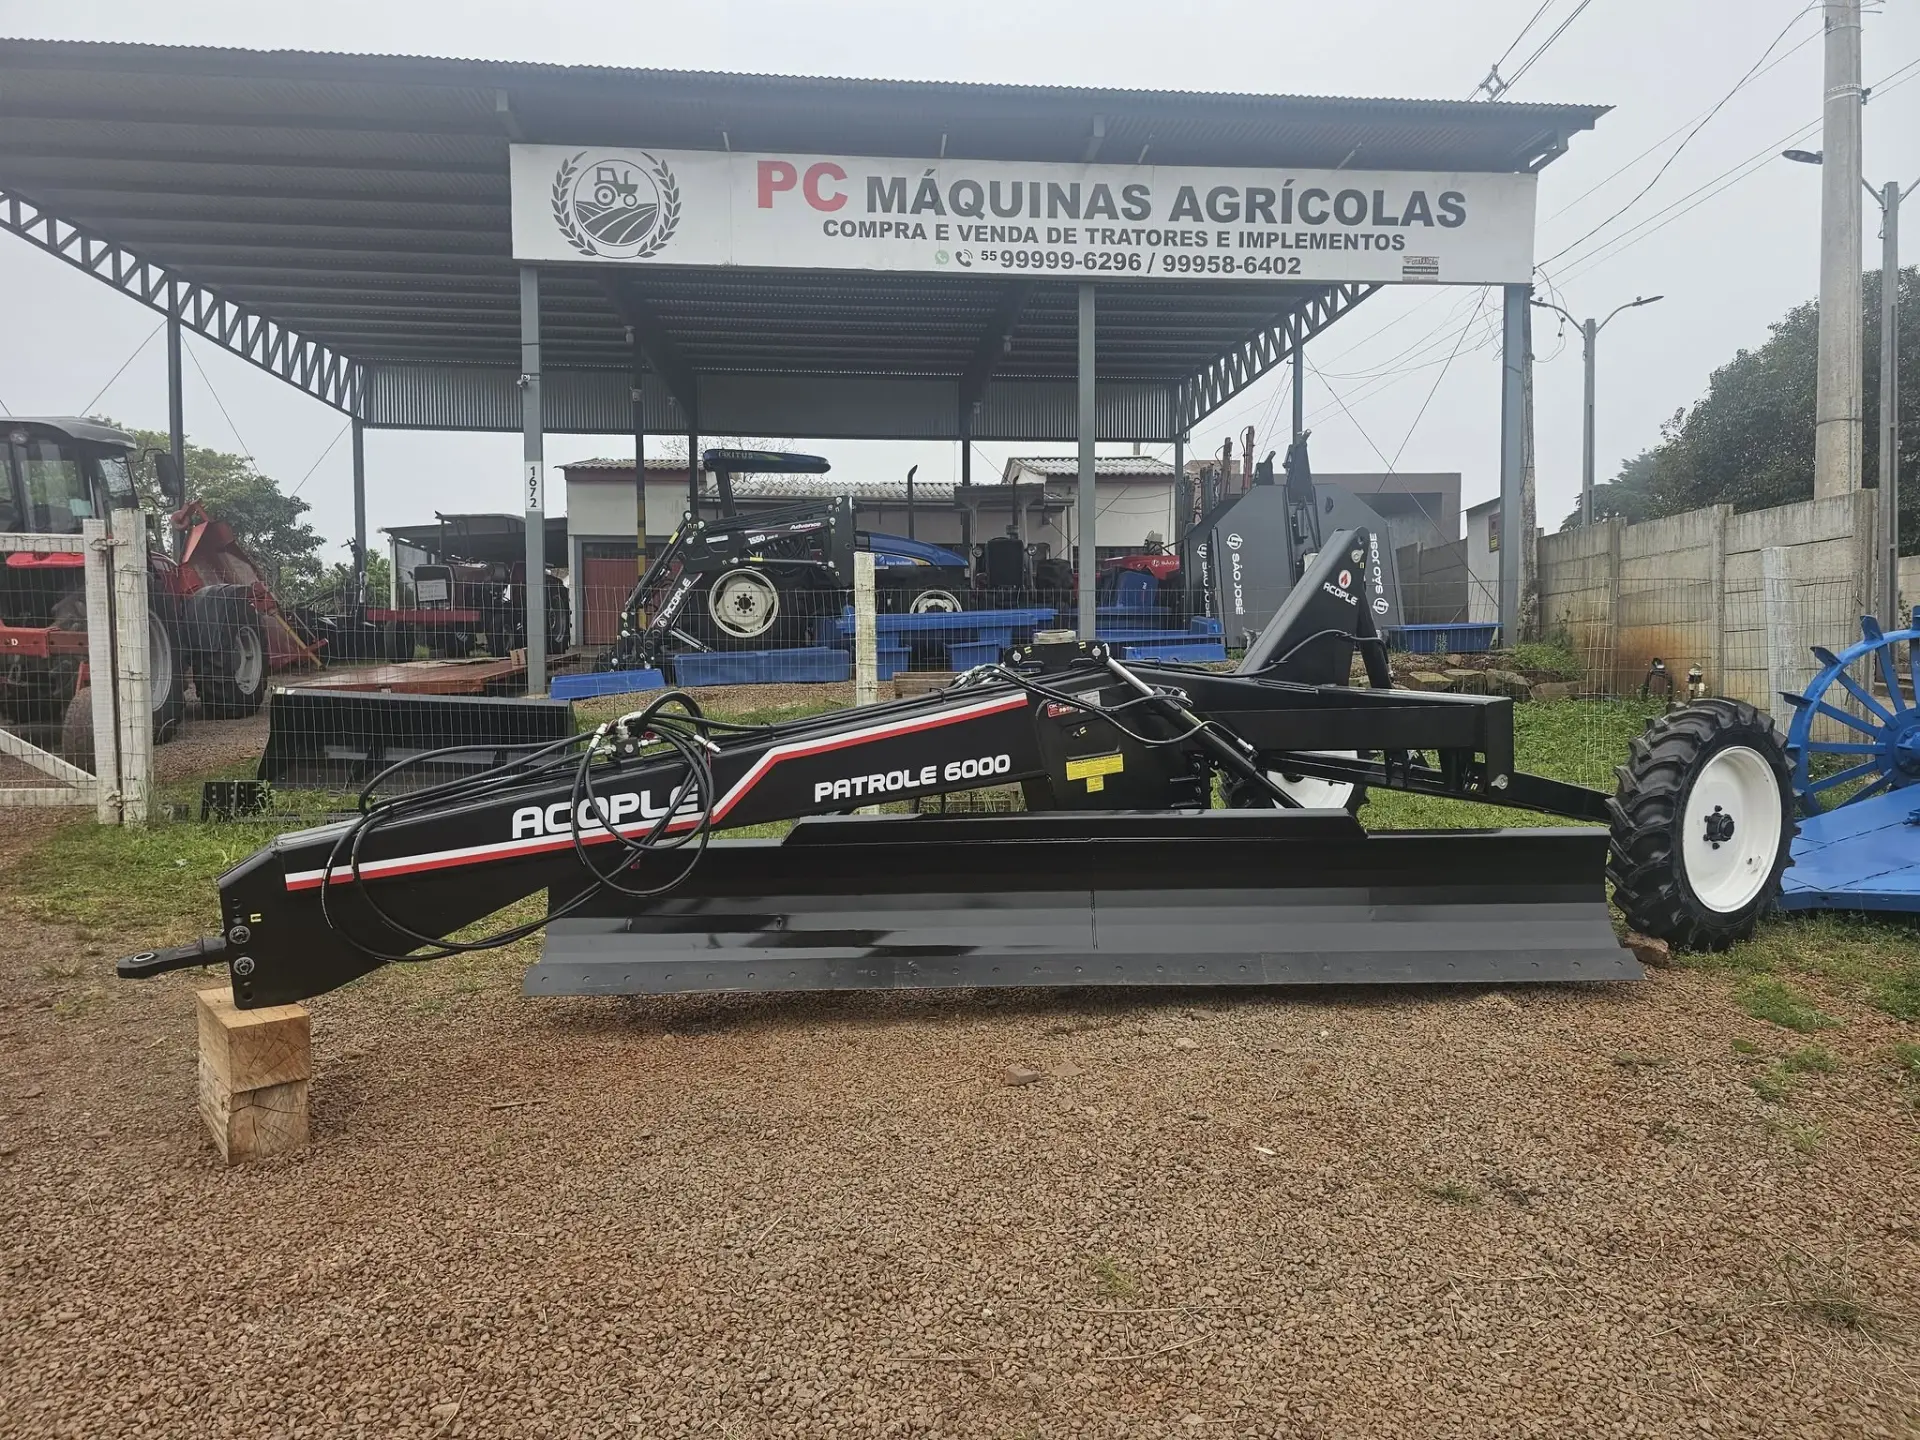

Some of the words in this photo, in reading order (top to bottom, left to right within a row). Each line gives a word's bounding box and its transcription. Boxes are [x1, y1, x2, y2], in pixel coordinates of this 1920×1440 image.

[757, 160, 848, 212] PC
[866, 169, 1152, 221] MÁQUINAS
[1168, 179, 1467, 228] AGRÍCOLAS
[823, 219, 928, 241] COMPRA
[935, 224, 950, 241] E
[957, 225, 1039, 244] VENDA
[1046, 226, 1077, 244] DE
[1085, 228, 1208, 247] TRATORES
[1216, 230, 1230, 248] E
[1238, 231, 1406, 251] IMPLEMENTOS
[981, 250, 997, 261] 55
[1000, 250, 1142, 271] 99999-6296
[1162, 254, 1301, 275] 99958-6402
[529, 465, 538, 508] 1672
[748, 534, 766, 545] 1550
[664, 577, 691, 618] ACOPLE
[1322, 582, 1358, 606] ACOPLE
[815, 765, 937, 803] PATROLE
[944, 754, 1011, 782] 6000
[512, 784, 699, 839] ACOPLE
